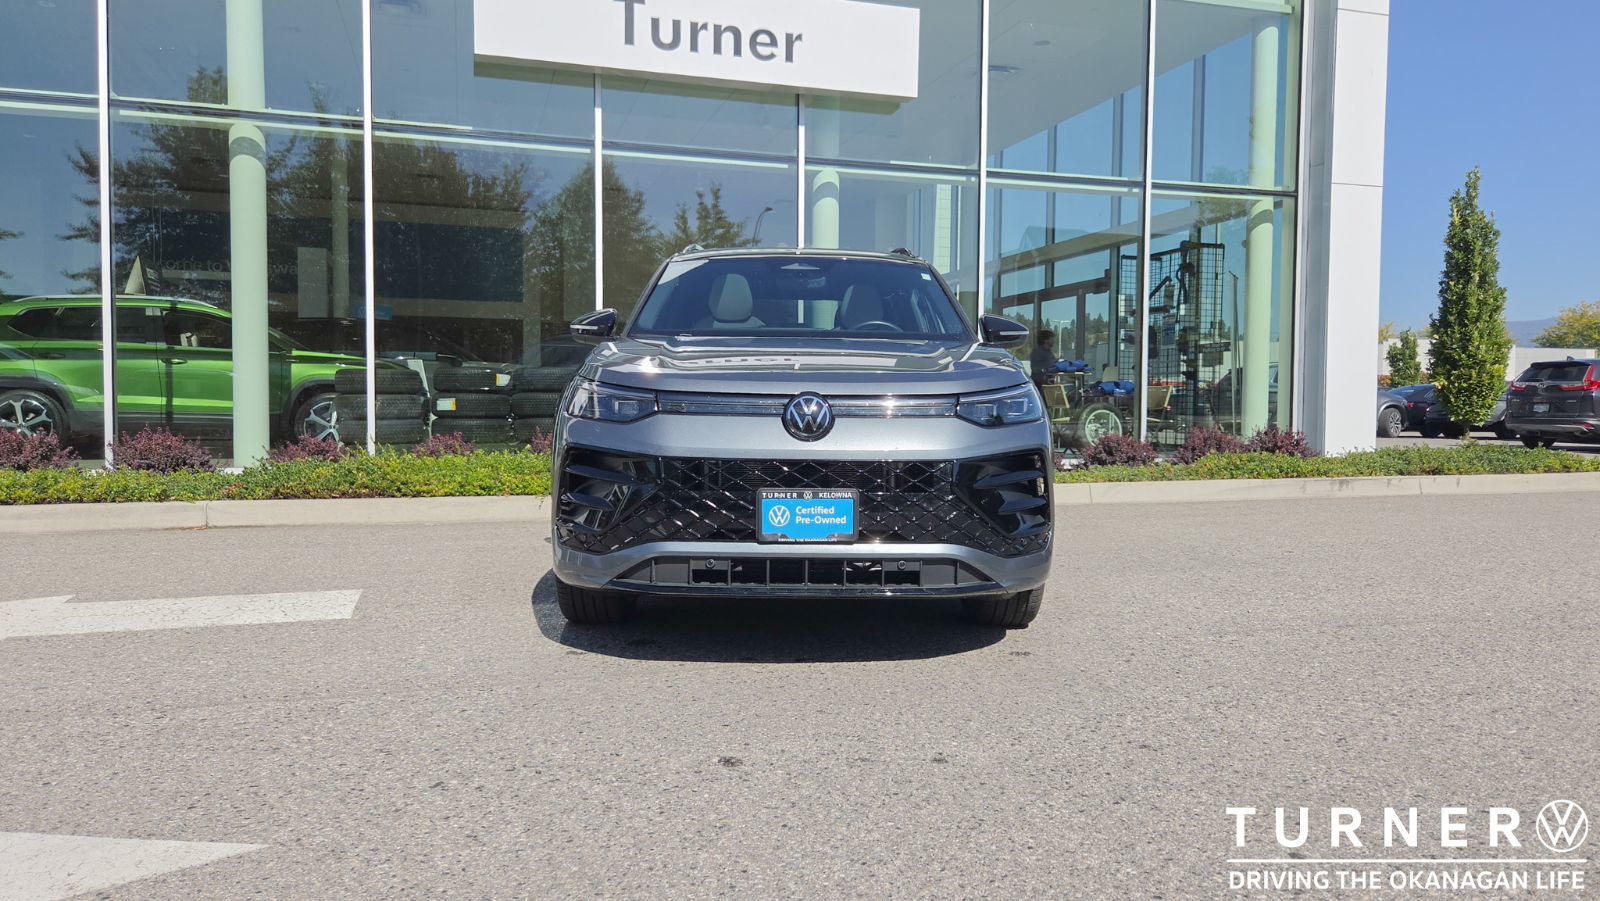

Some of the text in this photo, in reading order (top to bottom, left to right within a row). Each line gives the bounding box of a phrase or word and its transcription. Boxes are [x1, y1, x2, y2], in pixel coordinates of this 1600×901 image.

[613, 0, 803, 63] Turner
[795, 506, 835, 515] Certified
[795, 516, 847, 524] Pre-Owned
